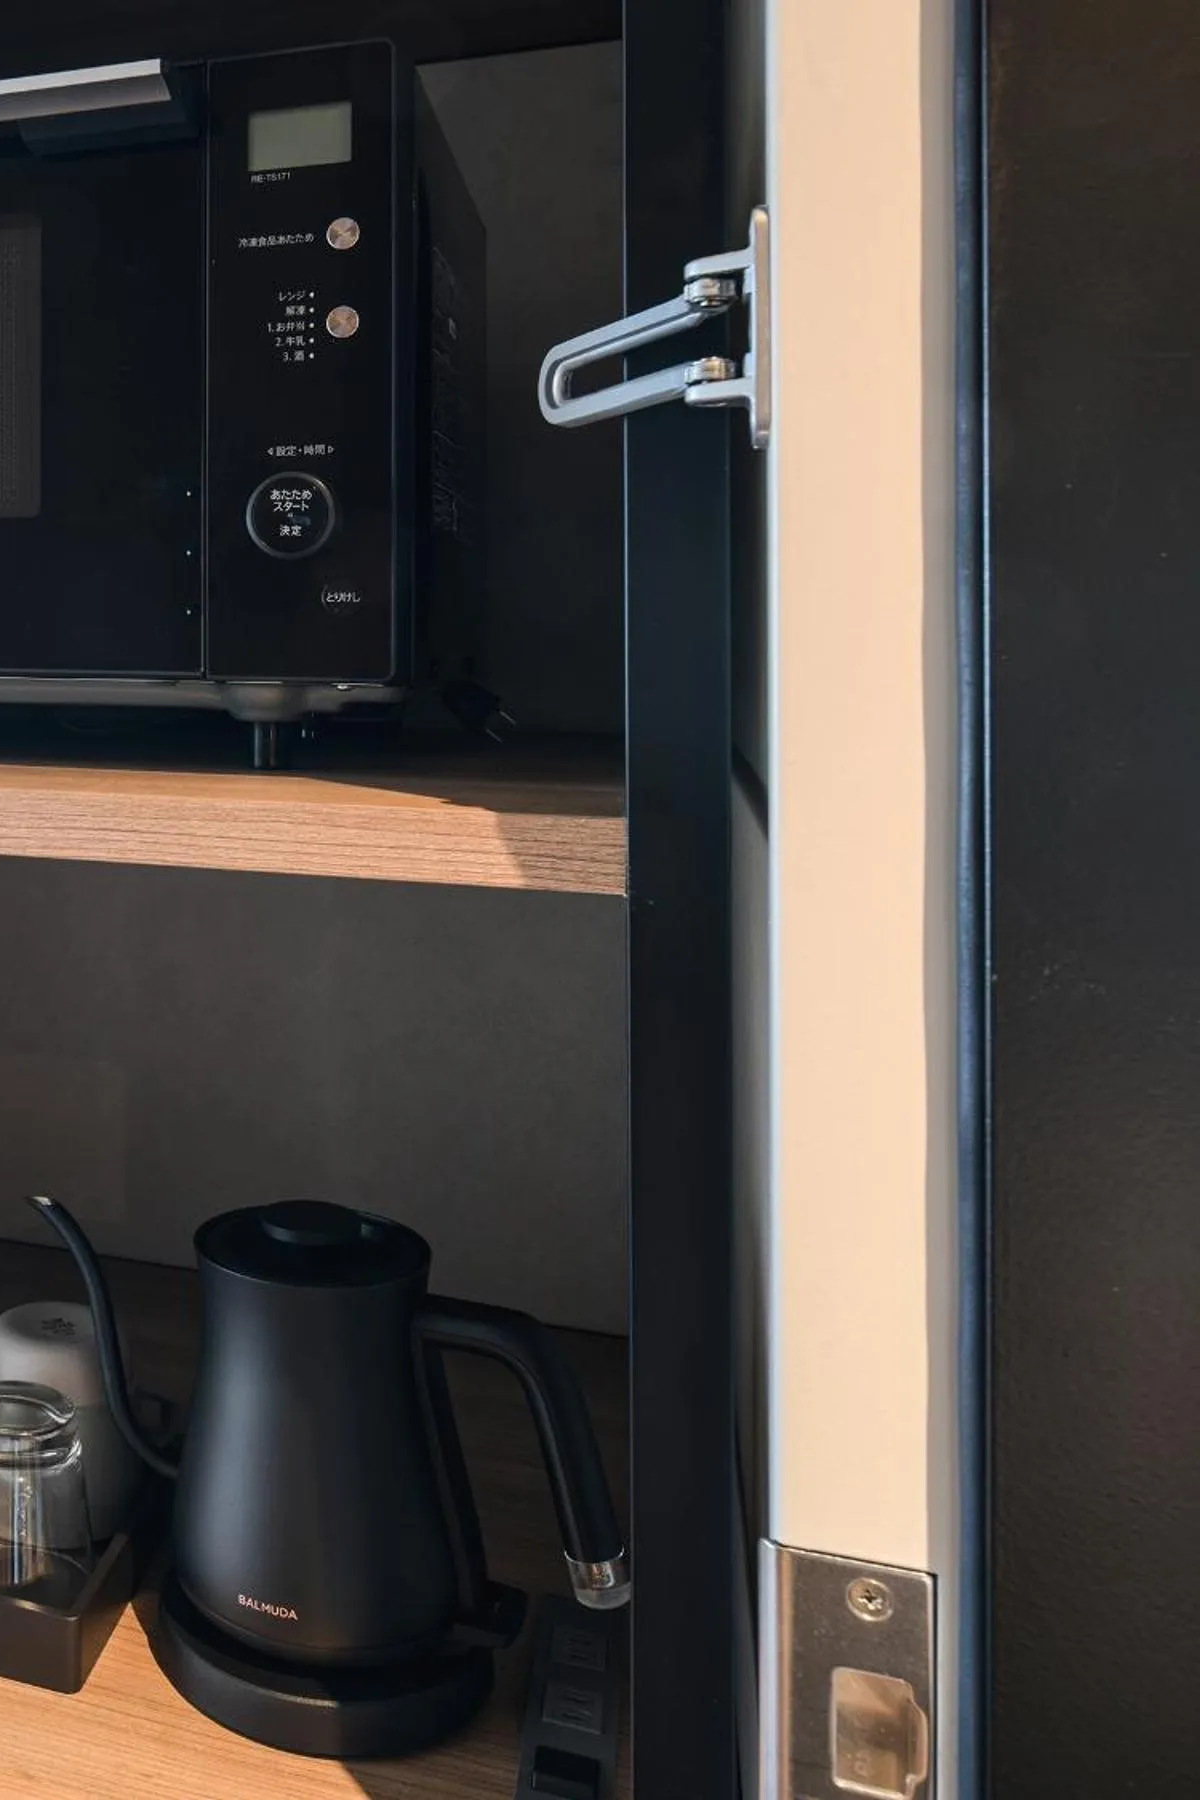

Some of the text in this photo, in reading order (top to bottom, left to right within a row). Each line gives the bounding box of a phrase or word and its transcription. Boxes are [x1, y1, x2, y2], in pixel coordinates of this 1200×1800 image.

[270, 489, 312, 500] あたため
[273, 500, 309, 511] スタート
[280, 525, 302, 536] 決定
[238, 1594, 299, 1621] BALMUDA
